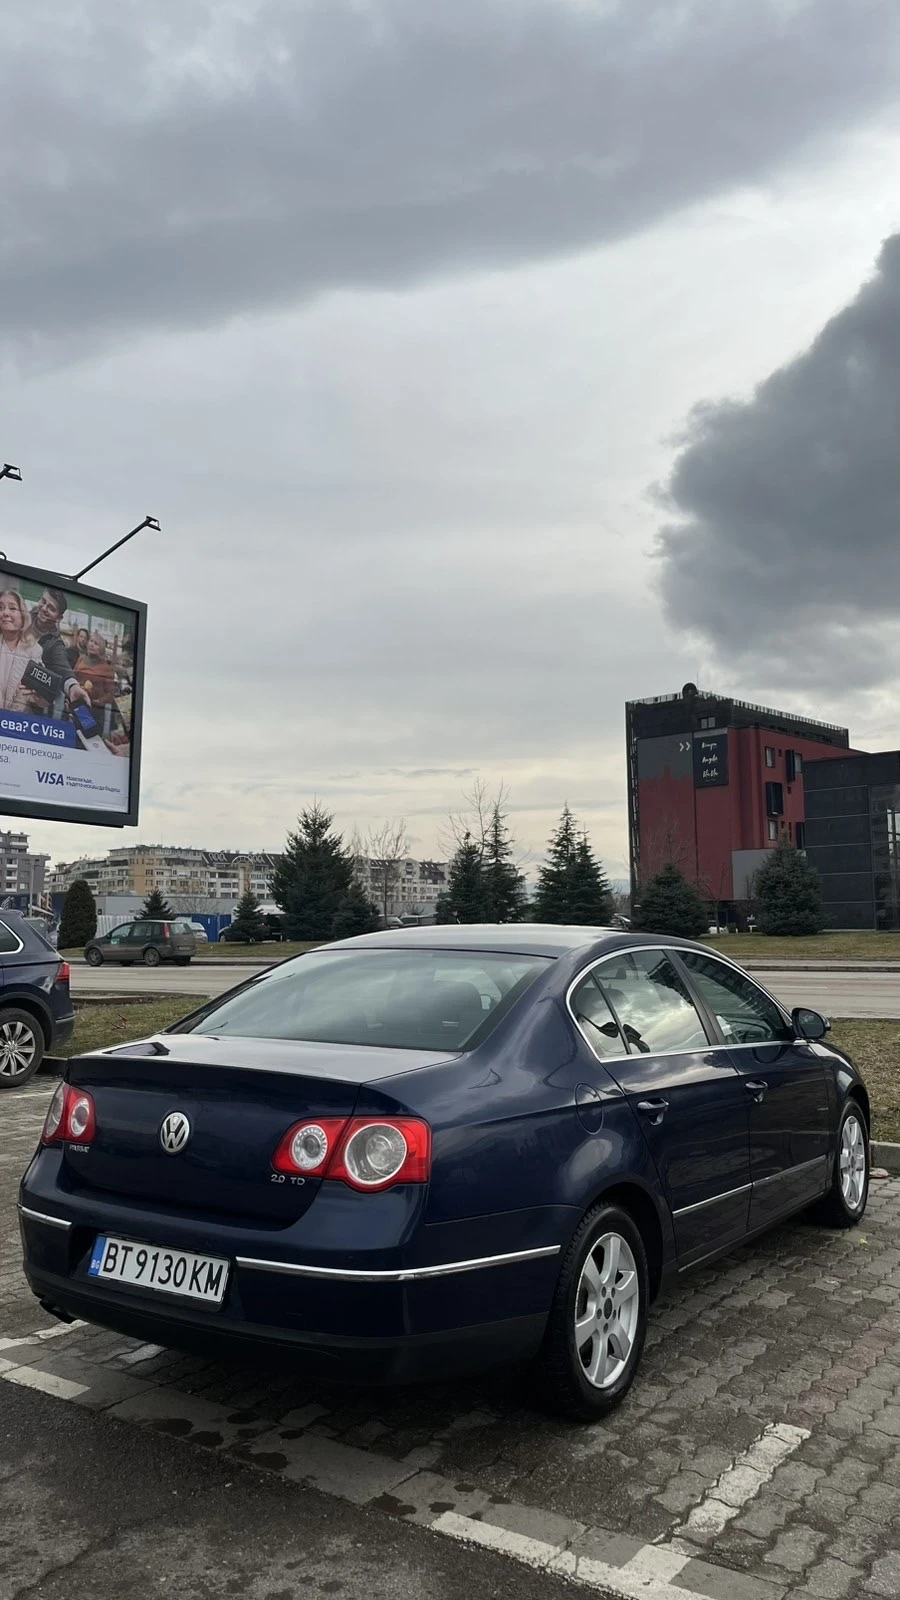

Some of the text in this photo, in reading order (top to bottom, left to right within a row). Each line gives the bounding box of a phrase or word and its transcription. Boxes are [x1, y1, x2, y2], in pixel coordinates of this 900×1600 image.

[31, 667, 52, 686] ЛЕВА
[0, 719, 65, 739] ева? С Visa
[20, 746, 25, 754] в
[35, 770, 64, 786] VISA
[90, 1259, 100, 1269] BG
